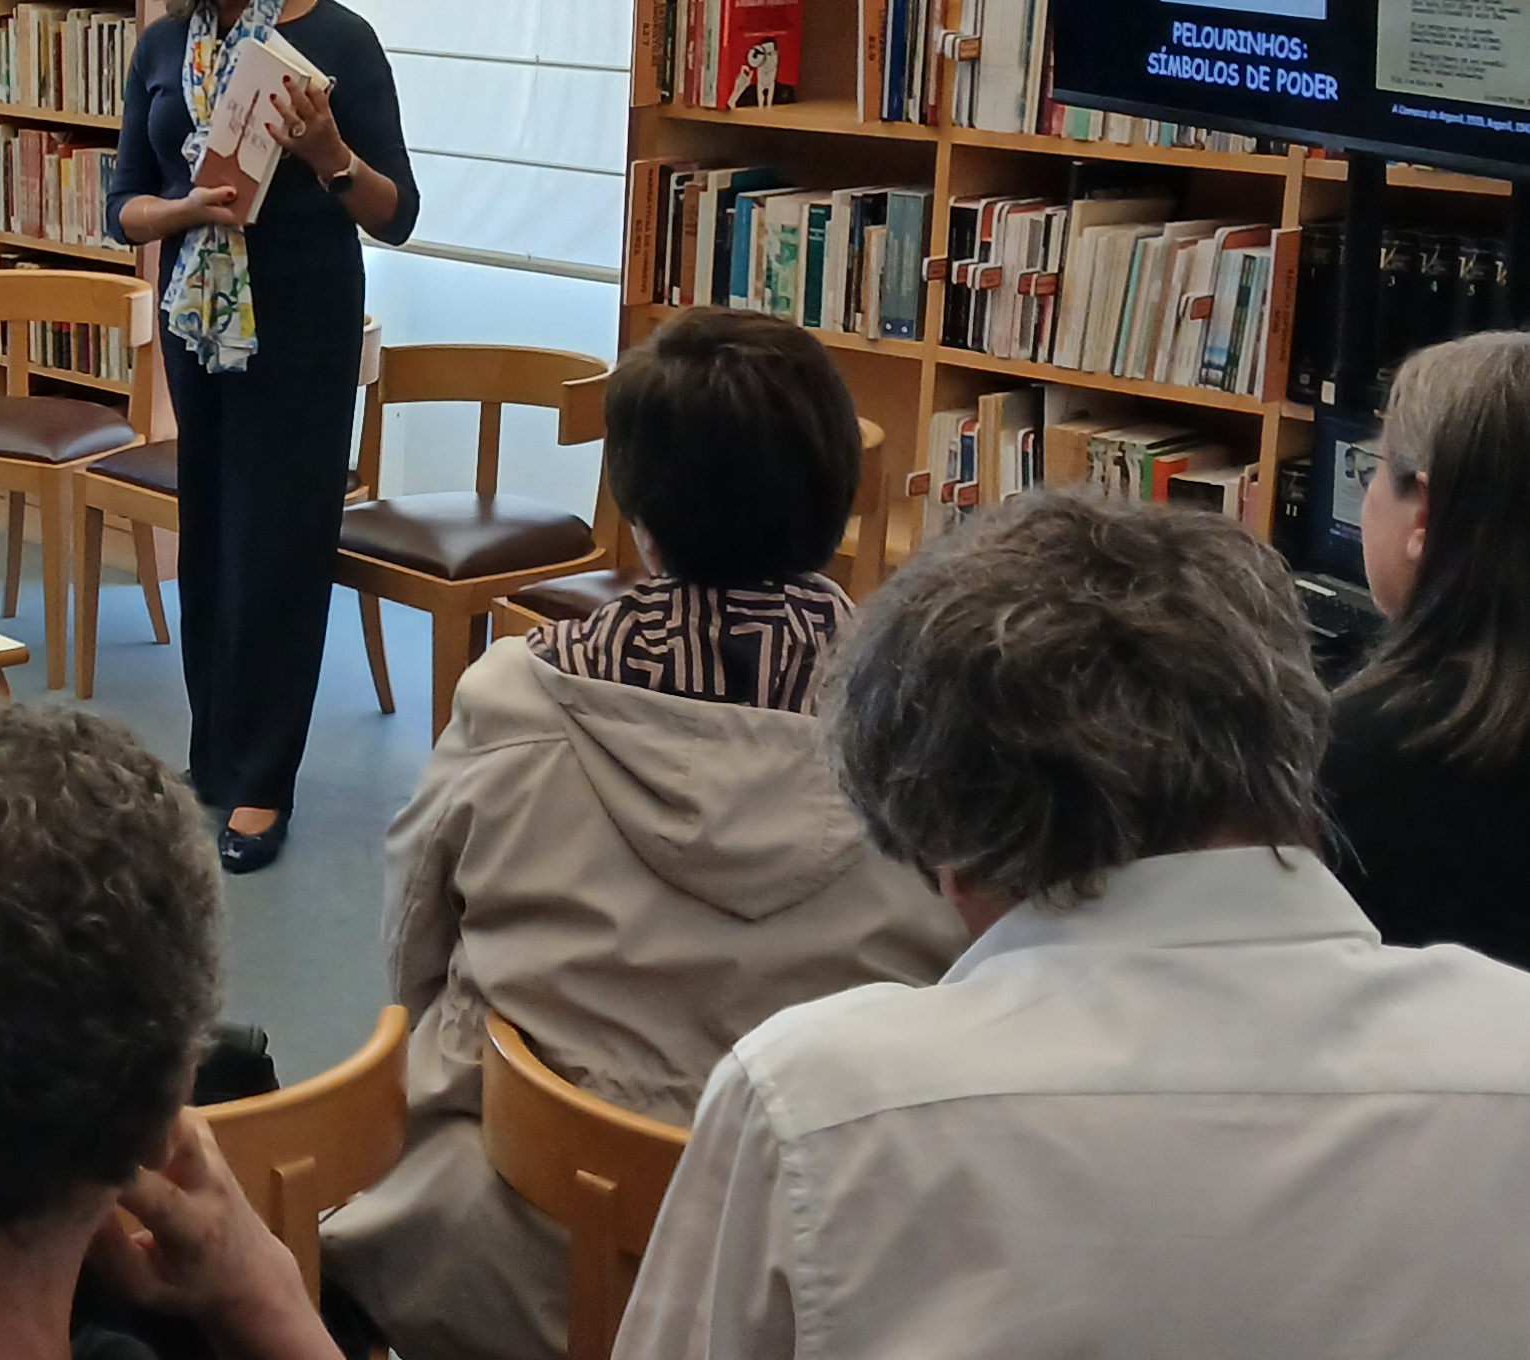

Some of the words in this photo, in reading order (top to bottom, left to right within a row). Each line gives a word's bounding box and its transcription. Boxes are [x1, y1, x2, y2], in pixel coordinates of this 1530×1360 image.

[1172, 21, 1308, 61] PELOURINHOS:
[1147, 45, 1239, 87] SÍMBOLOS
[1246, 64, 1270, 92] DE
[1276, 68, 1339, 101] PODER
